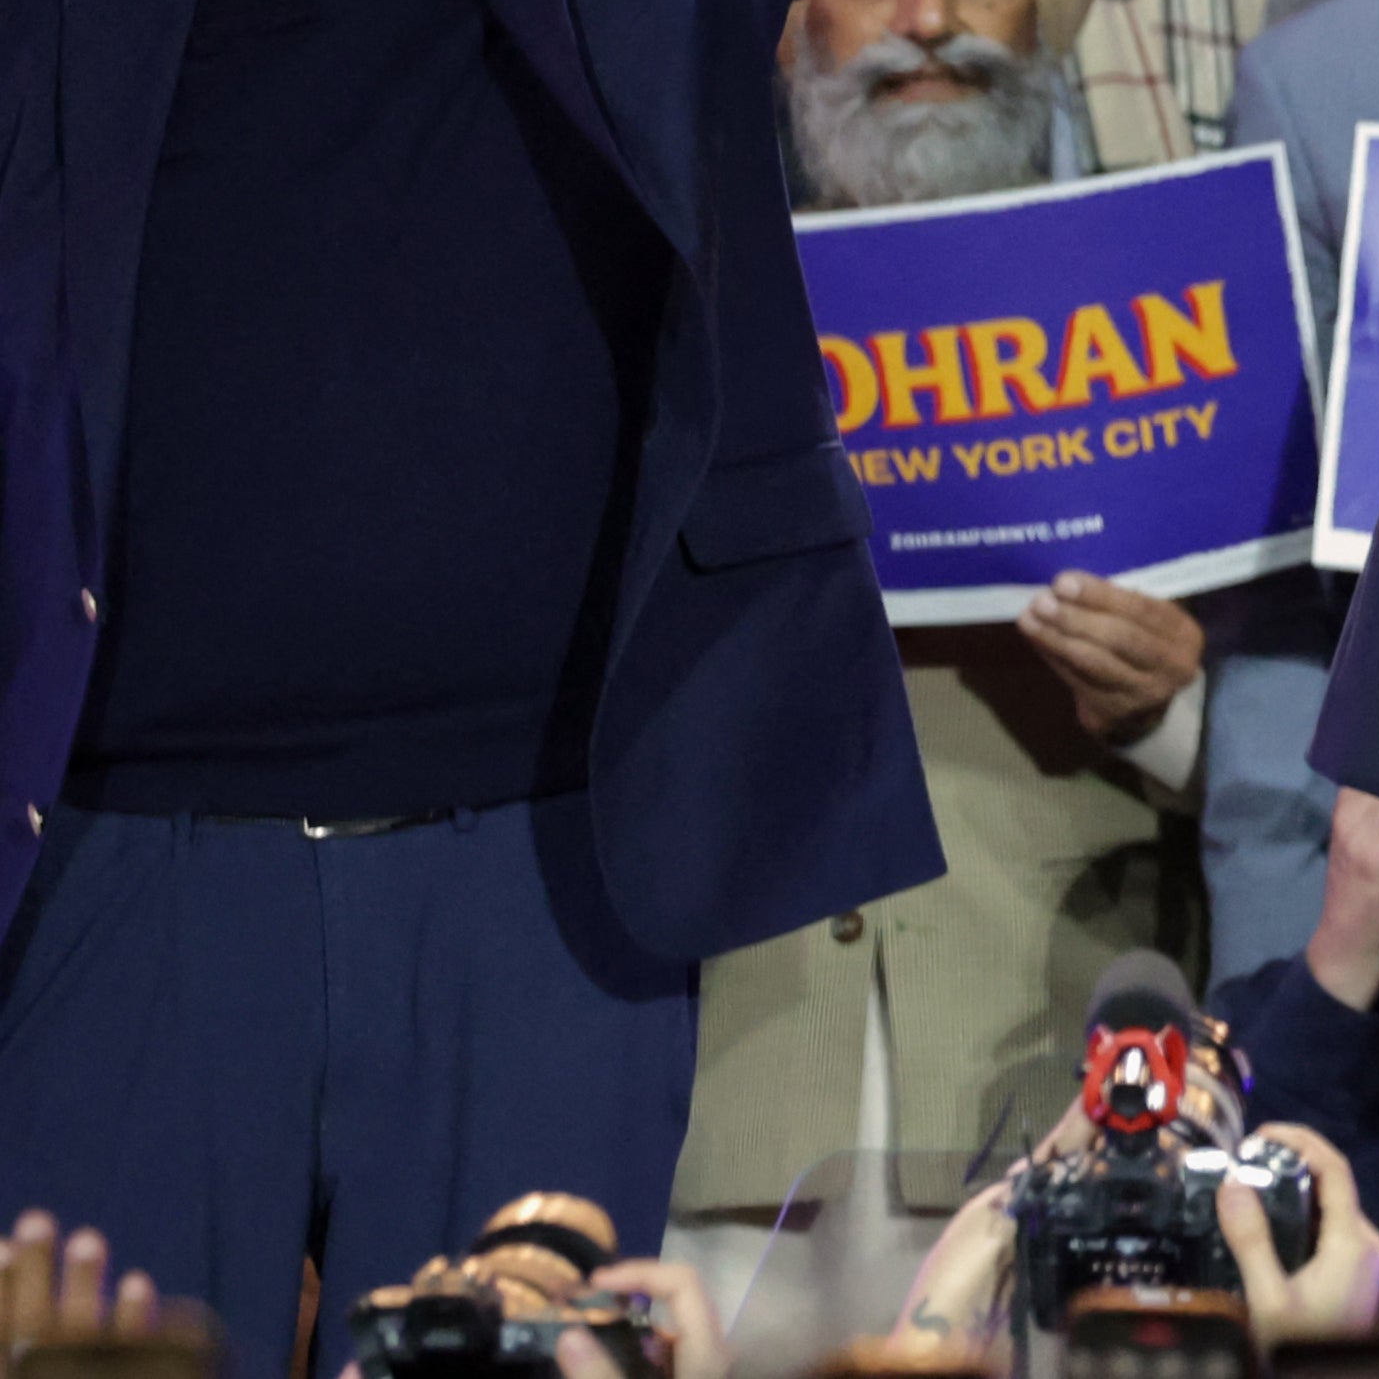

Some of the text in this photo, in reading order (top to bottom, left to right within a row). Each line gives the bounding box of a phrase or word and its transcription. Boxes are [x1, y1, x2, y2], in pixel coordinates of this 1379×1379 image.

[816, 278, 1238, 434] OHRAN
[952, 427, 1095, 479] YORK
[1103, 401, 1218, 458] CITY
